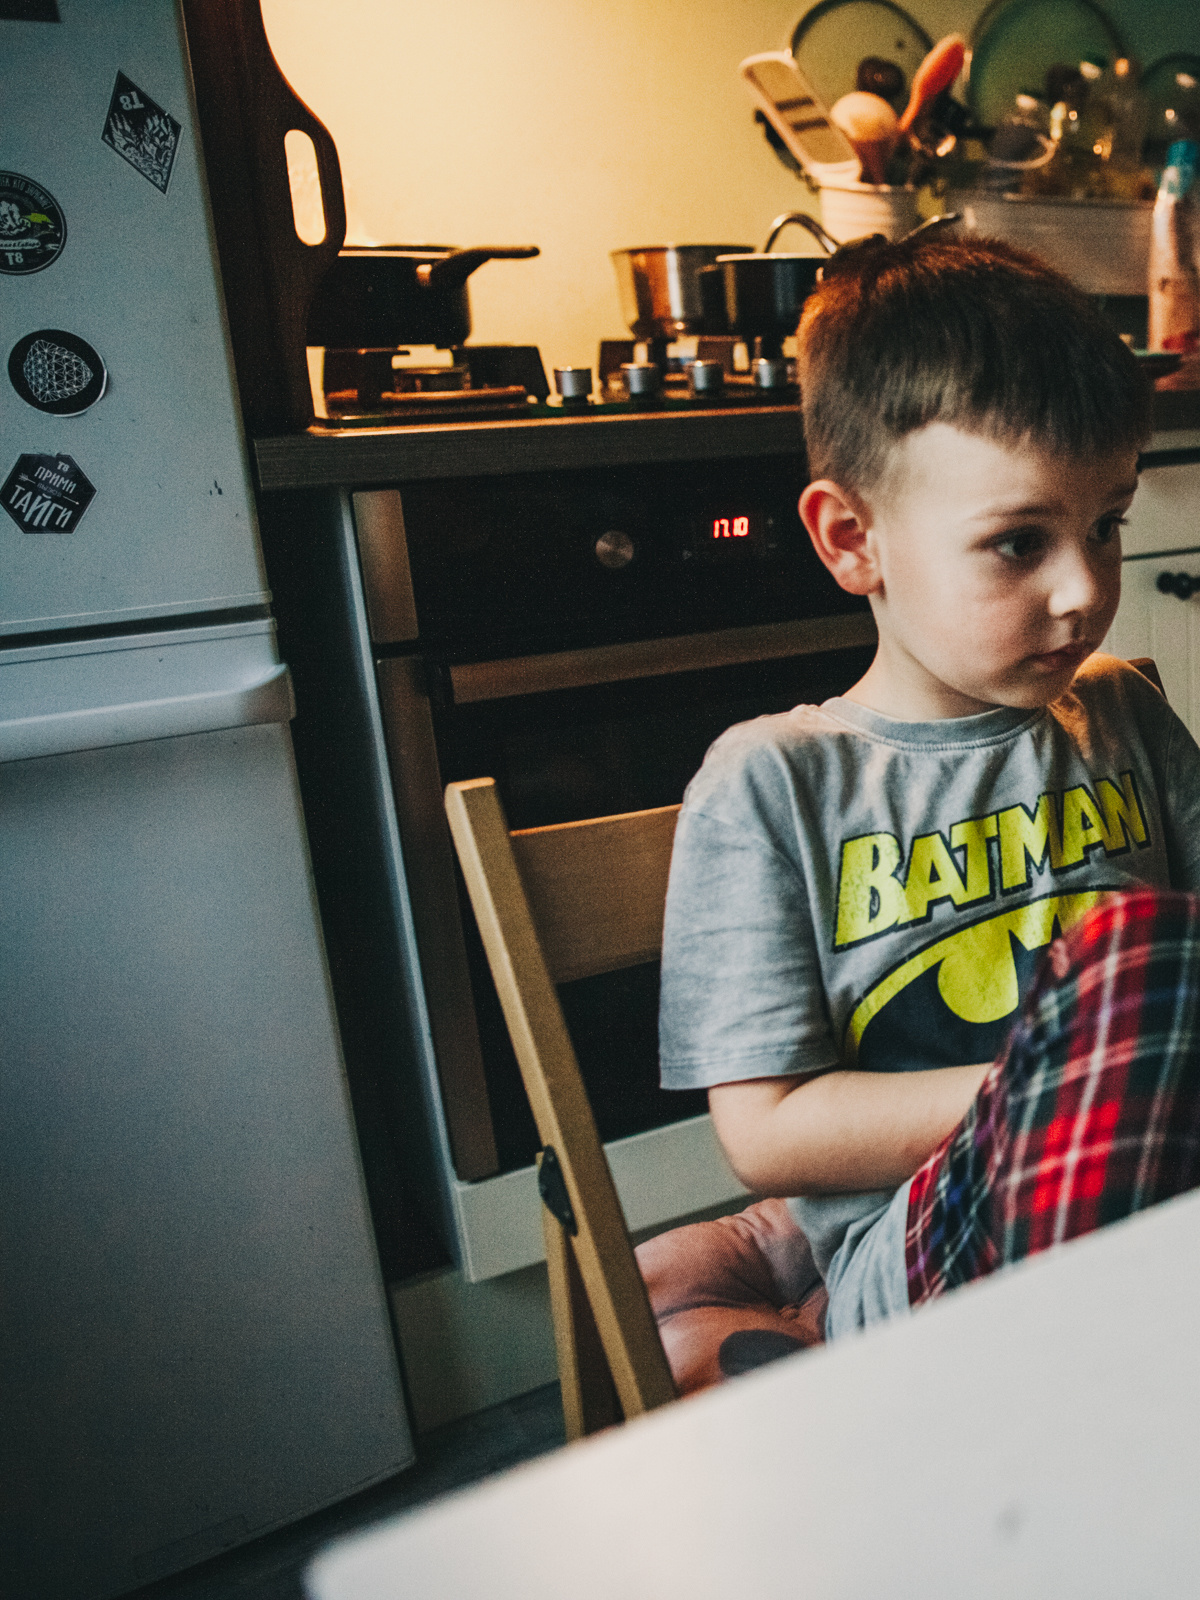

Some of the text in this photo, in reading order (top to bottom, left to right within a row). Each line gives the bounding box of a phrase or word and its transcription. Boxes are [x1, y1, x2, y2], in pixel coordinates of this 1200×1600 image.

[5, 252, 24, 265] T8
[34, 466, 77, 494] ПРИМИ
[9, 484, 73, 529] ТАЙГИ
[833, 769, 1151, 954] BATMAN
